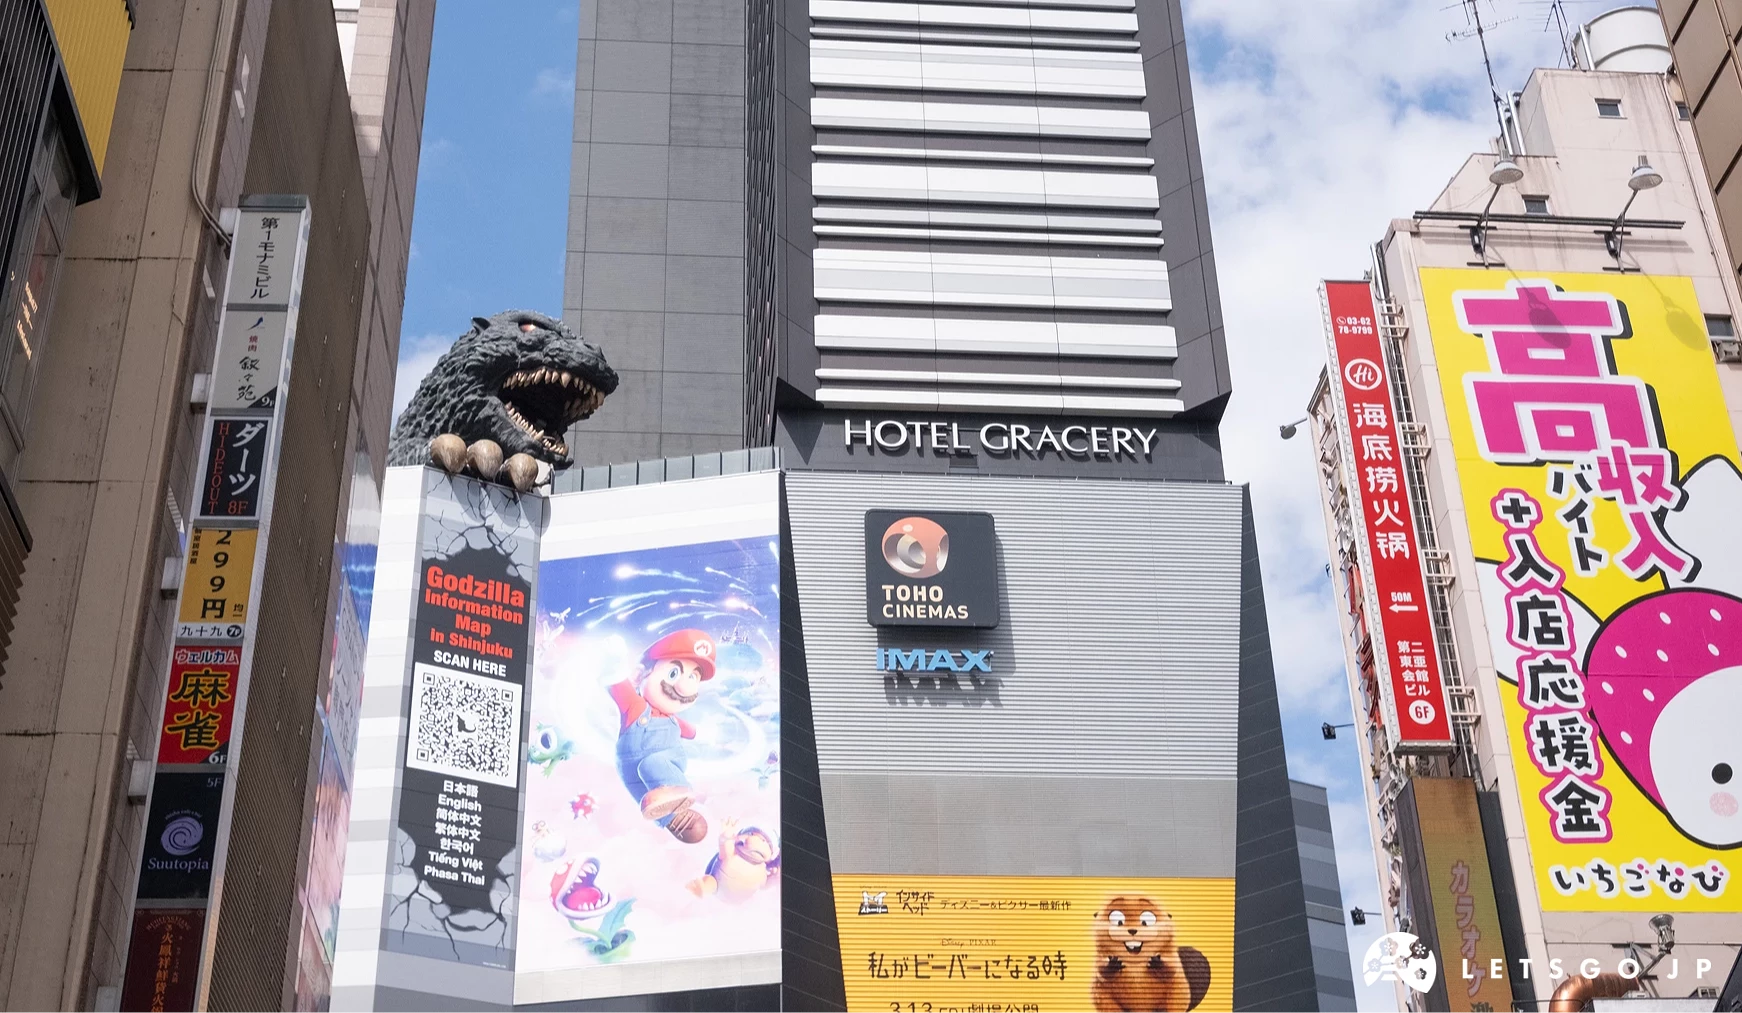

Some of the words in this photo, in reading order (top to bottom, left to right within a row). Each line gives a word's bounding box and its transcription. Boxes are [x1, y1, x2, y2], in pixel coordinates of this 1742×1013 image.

[1353, 364, 1374, 383] Hi
[844, 419, 971, 450] HOTEL
[979, 423, 1157, 454] GRACERY
[208, 422, 230, 514] HIDEOUT
[228, 422, 265, 496] ダーツ
[1353, 402, 1410, 559] 海底捞火锅
[228, 501, 248, 515] 8F
[1553, 464, 1602, 571] バイト
[427, 565, 525, 608] Godzilla
[882, 585, 943, 602] TOHO
[425, 588, 523, 625] Information
[1391, 592, 1412, 602] 50M
[882, 604, 969, 619] CINEMAS
[181, 626, 222, 637] 九十九
[455, 613, 492, 638] Map
[430, 628, 445, 643] in
[449, 632, 513, 659] Shinjuku
[1397, 640, 1424, 653] 第二
[175, 650, 239, 665] ウェルカム
[433, 650, 469, 669] SCAN
[472, 658, 507, 677] HERE
[876, 648, 992, 672] IMAX
[1405, 684, 1430, 696] ビル
[165, 668, 231, 750] 麻雀
[1414, 706, 1429, 718] 6F
[208, 751, 227, 764] 6F
[207, 777, 222, 788] 5F
[444, 779, 478, 798] 日本語
[438, 793, 482, 812] English
[440, 837, 475, 855] 한국어
[148, 858, 209, 873] Suutopia
[428, 851, 459, 868] Tiếng
[462, 857, 483, 871] Việt
[424, 864, 459, 881] Phasa
[461, 872, 485, 885] Thai
[1554, 863, 1725, 894] いちごなび
[903, 902, 930, 916] ヘッド
[1450, 860, 1486, 997] カラオケ
[868, 951, 1068, 980] 私がビーバーになる時
